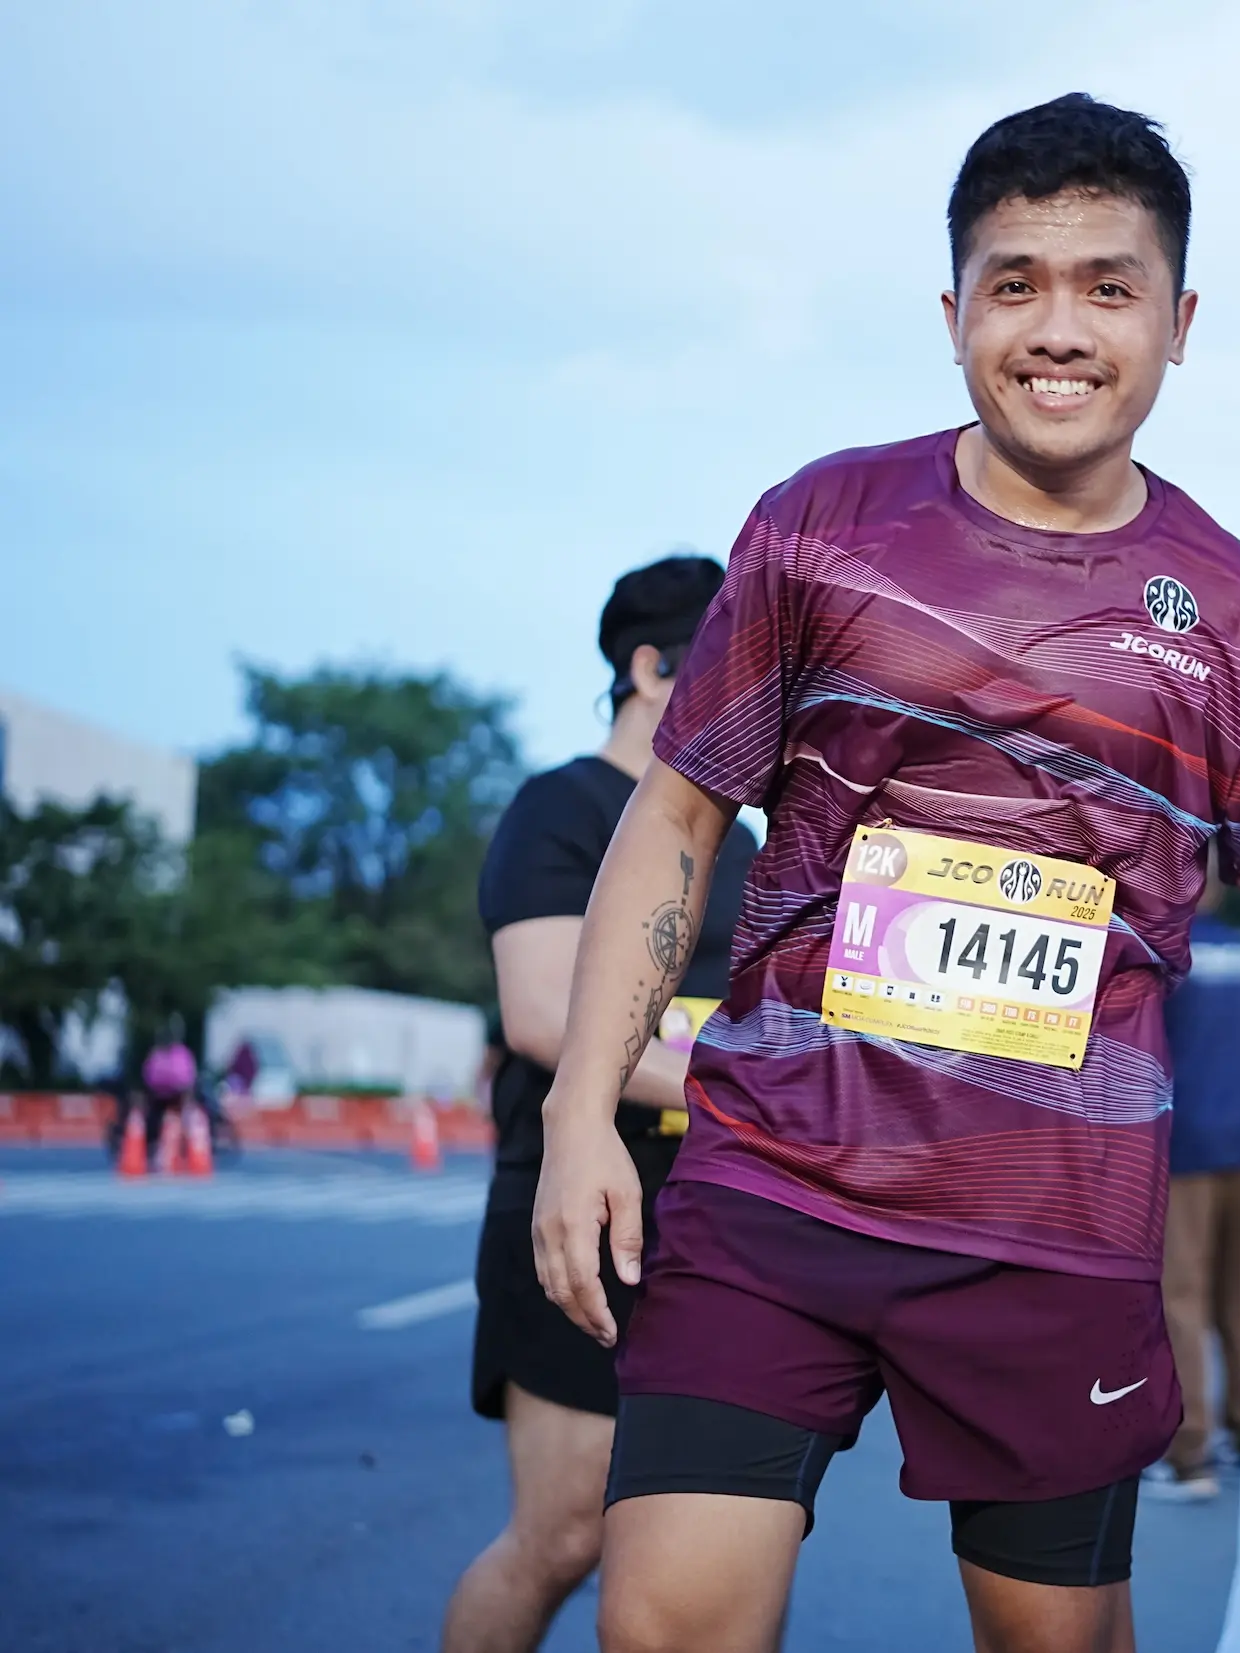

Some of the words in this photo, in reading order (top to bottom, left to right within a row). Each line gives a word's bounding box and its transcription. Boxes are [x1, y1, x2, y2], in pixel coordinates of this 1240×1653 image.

[856, 844, 901, 878] 12K
[927, 857, 994, 884] JCO
[1046, 878, 1105, 906] RUN
[842, 901, 878, 948] M
[1070, 905, 1097, 921] 2025
[844, 948, 865, 961] MALE
[938, 918, 1082, 995] 14145
